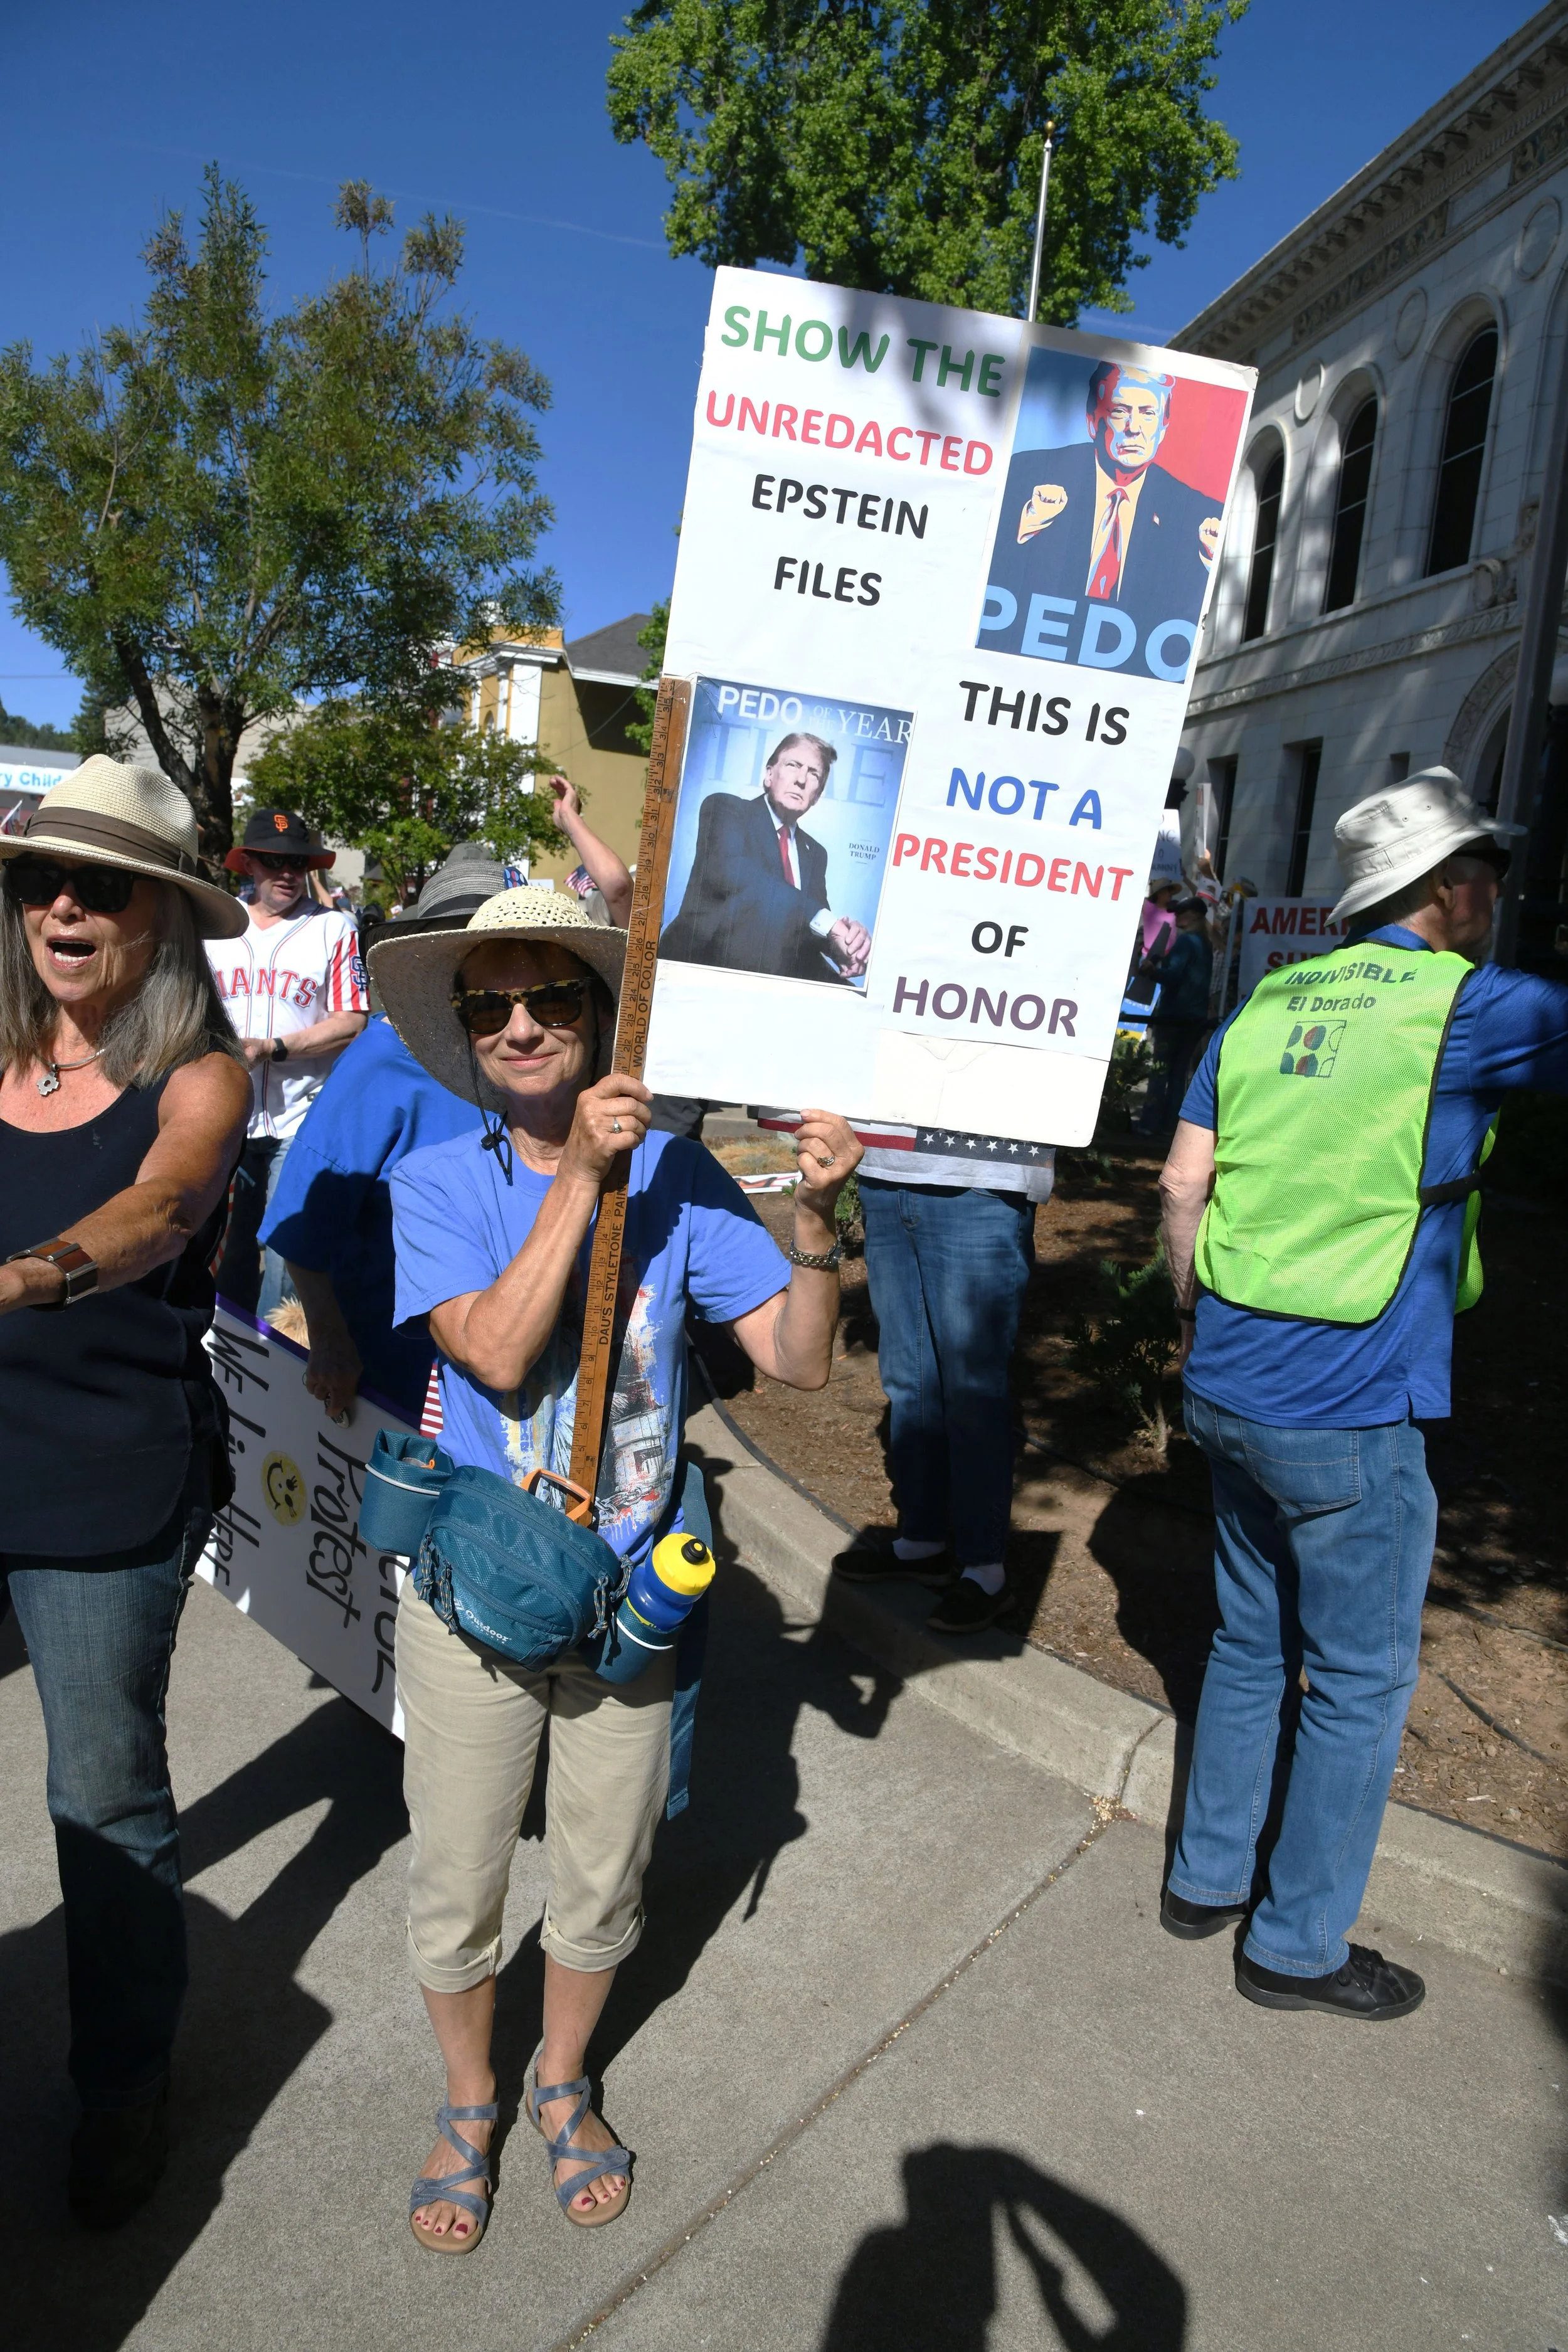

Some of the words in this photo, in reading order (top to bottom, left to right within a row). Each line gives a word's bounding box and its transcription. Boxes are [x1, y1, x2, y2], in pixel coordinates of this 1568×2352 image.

[721, 305, 890, 374] SHOW
[907, 339, 1005, 398] THE
[706, 389, 993, 475] UNREDACTED
[751, 474, 928, 539] EPSTEIN
[773, 556, 882, 607] FILES
[975, 585, 1197, 682] PEDO
[663, 697, 671, 712] 35
[718, 686, 803, 725] PEDO
[813, 706, 831, 718] OF
[837, 709, 913, 744] YEAR
[959, 681, 1071, 736] THIS
[1085, 702, 1130, 745] IS
[659, 726, 667, 740] 34
[657, 753, 664, 767] 33
[0, 773, 12, 787] y
[654, 780, 661, 794] 32
[946, 767, 1059, 820] NOT
[1069, 790, 1103, 830] A
[650, 809, 658, 821] 31
[274, 815, 289, 832] SF
[647, 833, 655, 847] 30
[849, 842, 880, 853] DONALD
[850, 850, 876, 861] TRUMP
[644, 860, 652, 873] 29
[893, 834, 1133, 901] PRESIDENT
[642, 886, 649, 900] 28
[638, 912, 645, 926] 27
[635, 938, 643, 951] 26
[971, 921, 1029, 958] OF
[632, 963, 640, 977] 25
[640, 941, 656, 990] COLOR
[1285, 961, 1419, 985] INDIVISIBLE
[217, 967, 319, 1009] IANTS
[629, 988, 637, 1002] 24
[638, 993, 649, 1013] OF
[893, 977, 1078, 1037] HONOR
[1287, 996, 1308, 1012] El
[1310, 993, 1377, 1012] Dorado
[627, 1014, 634, 1027] 23
[623, 1039, 631, 1052] 22
[633, 1017, 647, 1067] WORLD
[604, 1209, 612, 1220] 15
[601, 1234, 608, 1247] 14
[598, 1257, 606, 1267] 13
[605, 1223, 622, 1302] STYLETONE
[596, 1280, 603, 1290] 12
[594, 1305, 600, 1313] 11
[591, 1326, 598, 1337] 10
[599, 1307, 612, 1345] DAU'S
[465, 1610, 509, 1642] Outdoor
